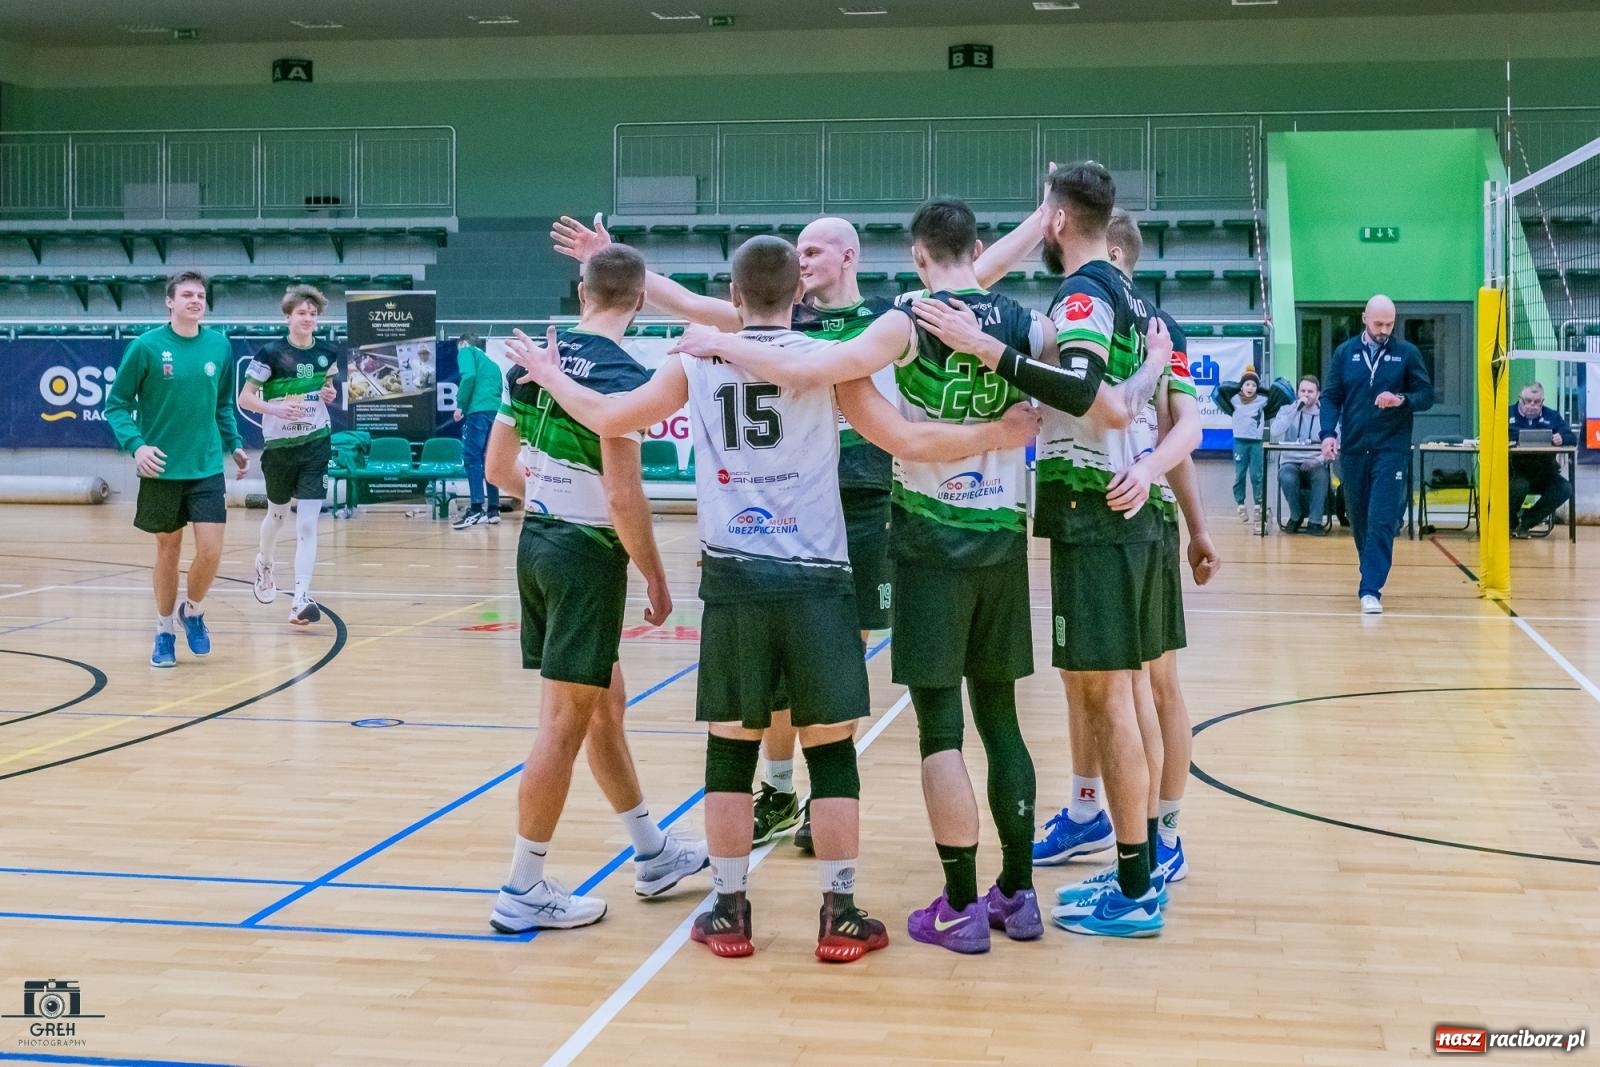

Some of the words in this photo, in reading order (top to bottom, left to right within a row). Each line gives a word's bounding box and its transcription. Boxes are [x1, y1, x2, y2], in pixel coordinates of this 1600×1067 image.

[952, 52, 964, 66] B
[973, 51, 988, 65] B
[288, 66, 308, 80] A
[368, 311, 414, 321] SZYPUŁA
[163, 363, 174, 376] R
[296, 363, 314, 378] 98
[1189, 354, 1220, 386] ch
[713, 382, 784, 451] 15
[937, 485, 1004, 501] UBEZPIECZENIA
[769, 516, 797, 526] MULTI
[877, 582, 892, 610] 19
[1080, 787, 1096, 799] R
